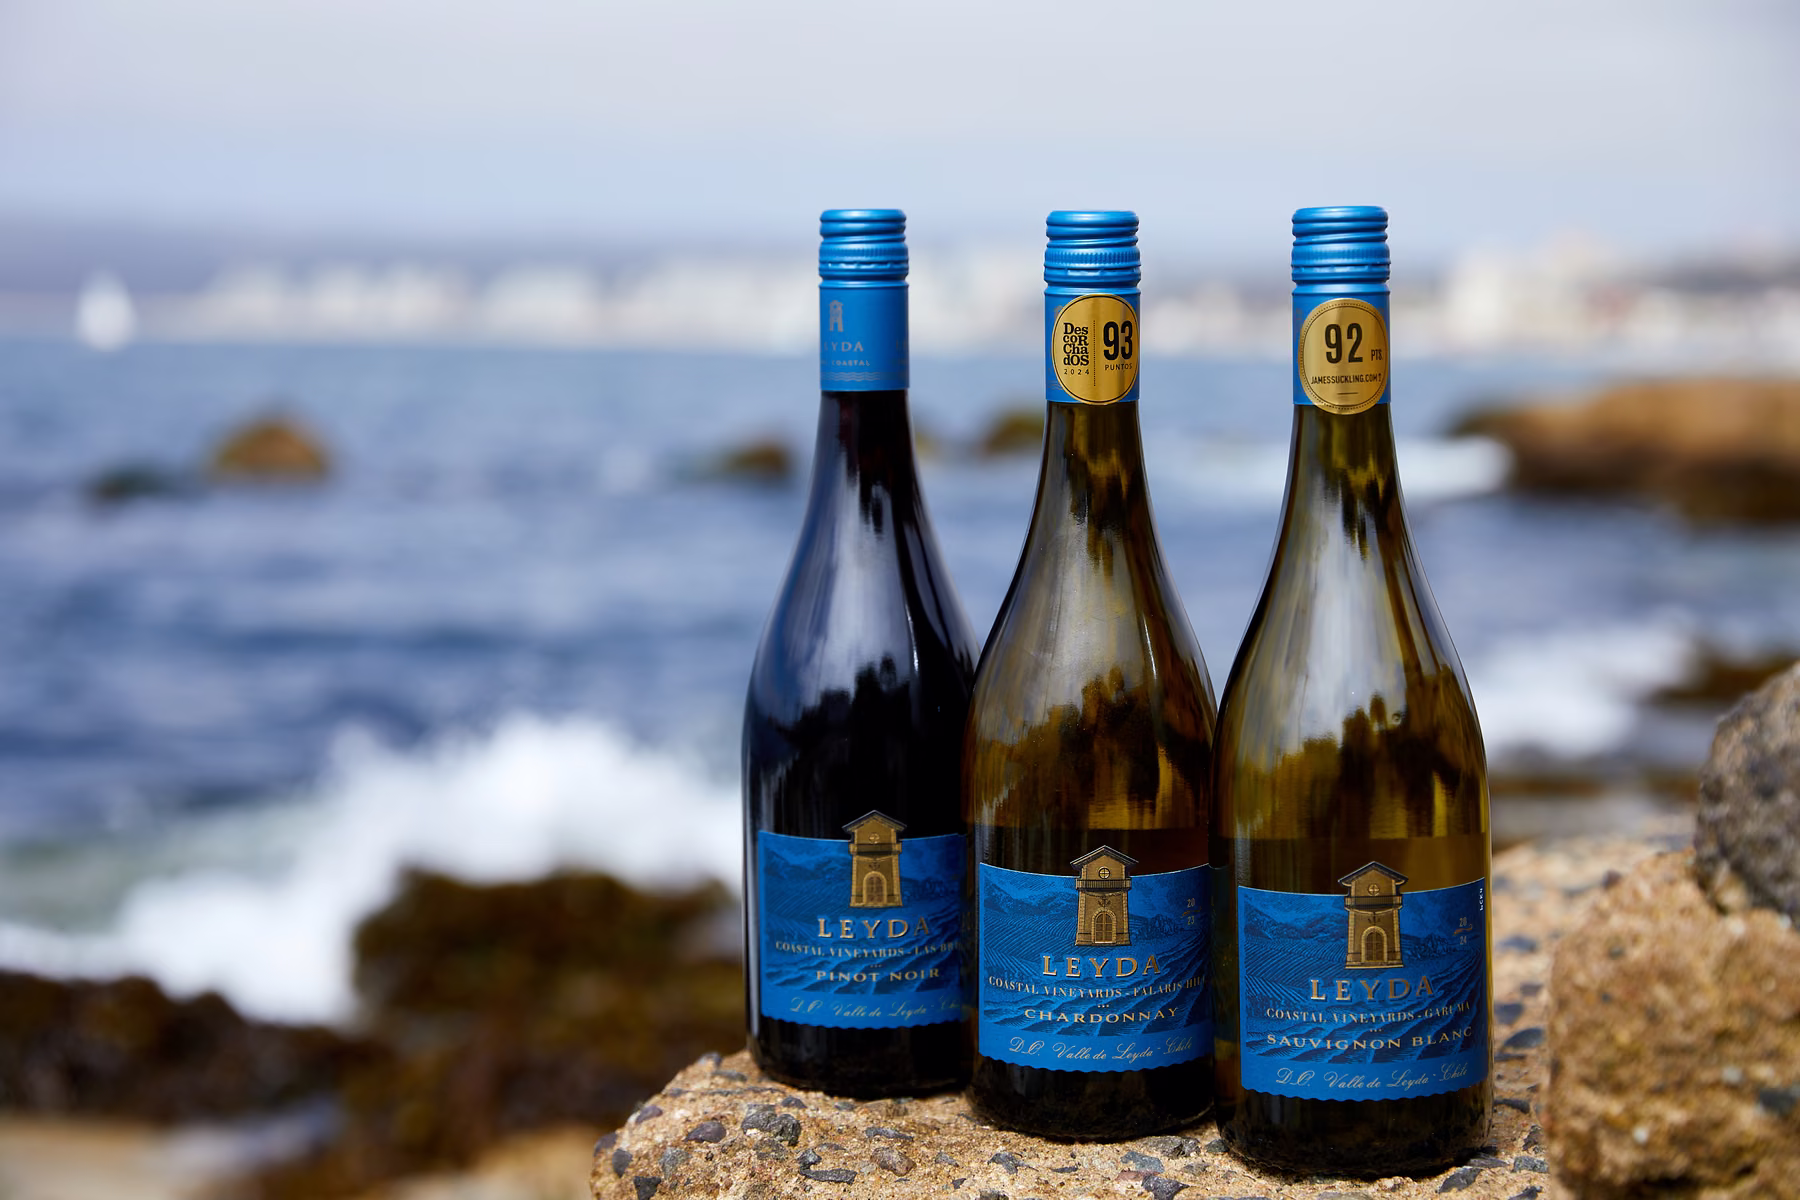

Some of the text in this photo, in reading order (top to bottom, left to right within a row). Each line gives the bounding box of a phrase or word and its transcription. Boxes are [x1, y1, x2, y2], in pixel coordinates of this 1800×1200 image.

[1063, 322, 1089, 335] Des
[1063, 343, 1089, 354] Cha
[1103, 320, 1133, 360] 93
[1325, 323, 1363, 364] 92
[1105, 363, 1133, 371] PUNTOS
[1187, 898, 1196, 908] 20
[817, 916, 929, 939] LEYDA
[1187, 916, 1195, 925] 23
[1459, 916, 1467, 927] 20
[775, 940, 825, 956] COASTAL
[829, 947, 905, 958] VINEYARDS
[1459, 935, 1467, 945] 24
[816, 968, 939, 983] PINOT NOIR
[1042, 954, 1161, 978] LEYDA
[988, 976, 1039, 995] COASTAL
[1044, 985, 1123, 999] VINEYARDS
[1133, 982, 1183, 997] FALARIS
[1310, 976, 1434, 1001] LEYDA
[832, 1002, 869, 1018] Valle
[871, 1008, 882, 1018] de
[887, 1001, 927, 1021] Leyda
[1024, 1007, 1178, 1024] CHARDONNAY
[1266, 1001, 1470, 1024] COASTAL VINEYARDS GARUMA
[1267, 1026, 1472, 1050] SAUVIGNON BLANC
[1052, 1042, 1091, 1060] Valle
[1092, 1049, 1107, 1060] de
[1112, 1043, 1153, 1064] Leyda
[1163, 1036, 1193, 1054] Chile
[1324, 1071, 1364, 1089] Valle
[1366, 1077, 1381, 1089] de
[1386, 1071, 1429, 1092] Leyda
[1439, 1062, 1468, 1082] Chile
